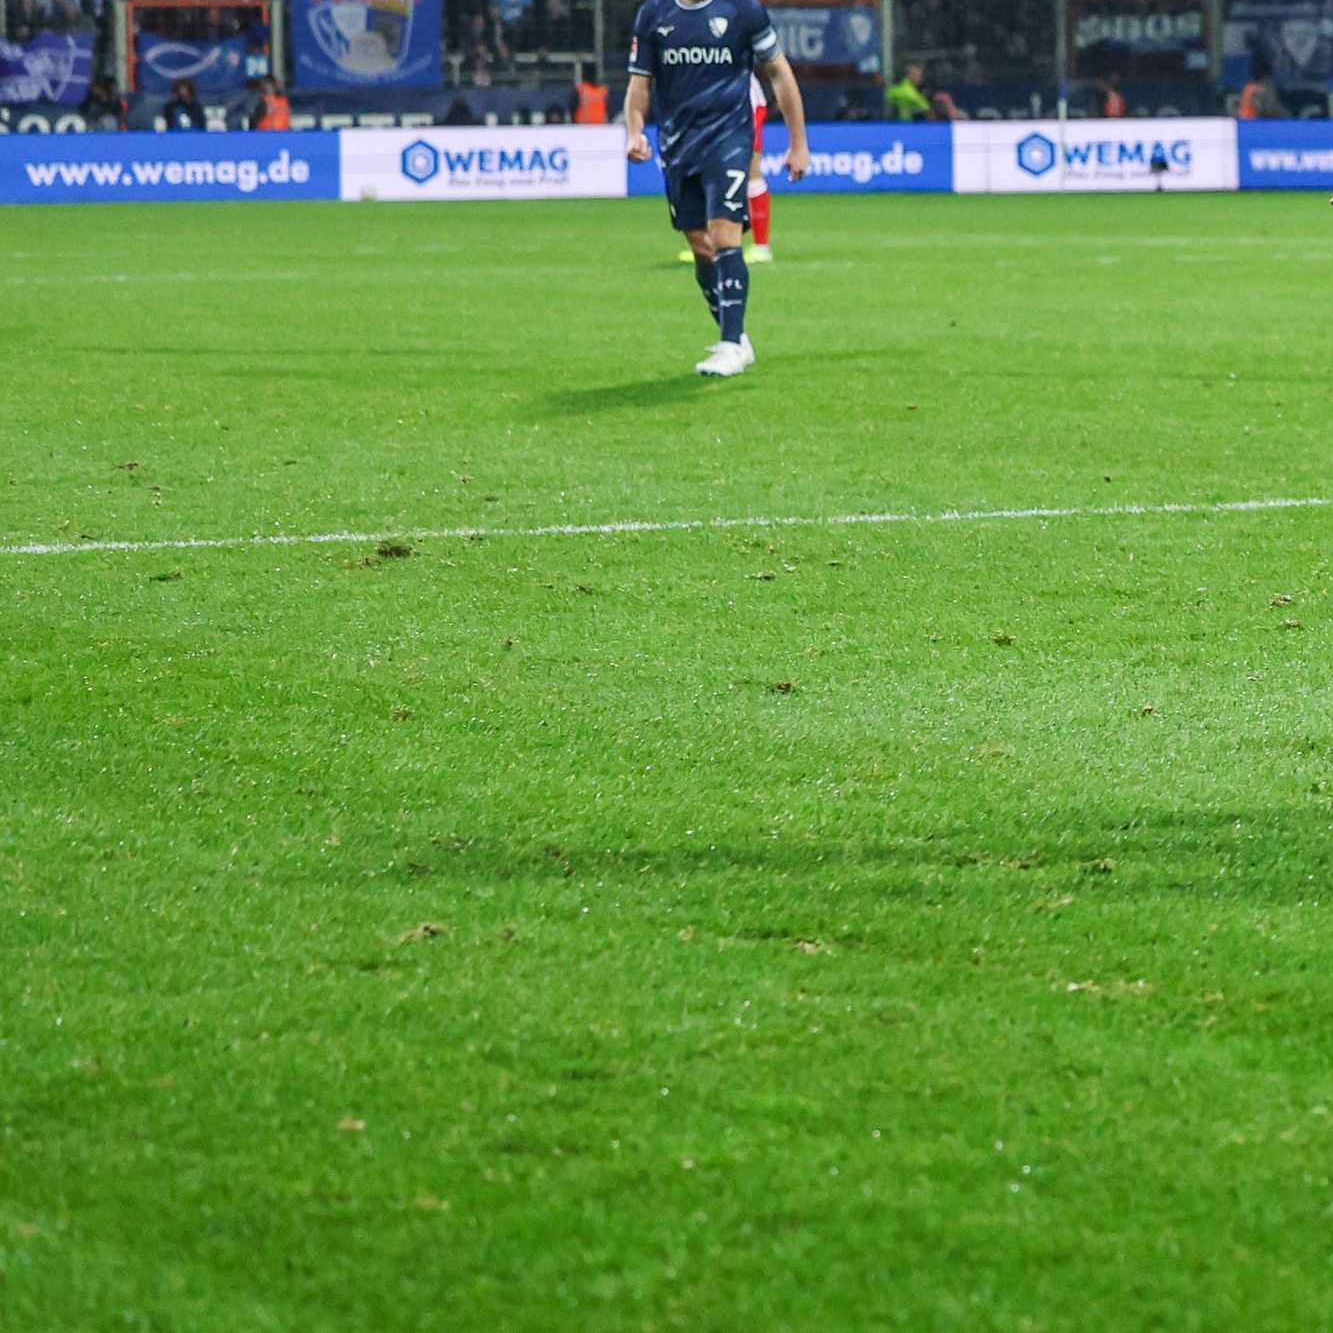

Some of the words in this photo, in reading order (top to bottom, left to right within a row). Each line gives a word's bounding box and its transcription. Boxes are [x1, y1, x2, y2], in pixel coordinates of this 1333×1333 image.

[444, 148, 570, 172] WEMAG
[1063, 140, 1193, 166] WEMAG
[26, 149, 310, 192] www.wemag.de
[725, 169, 746, 200] 7
